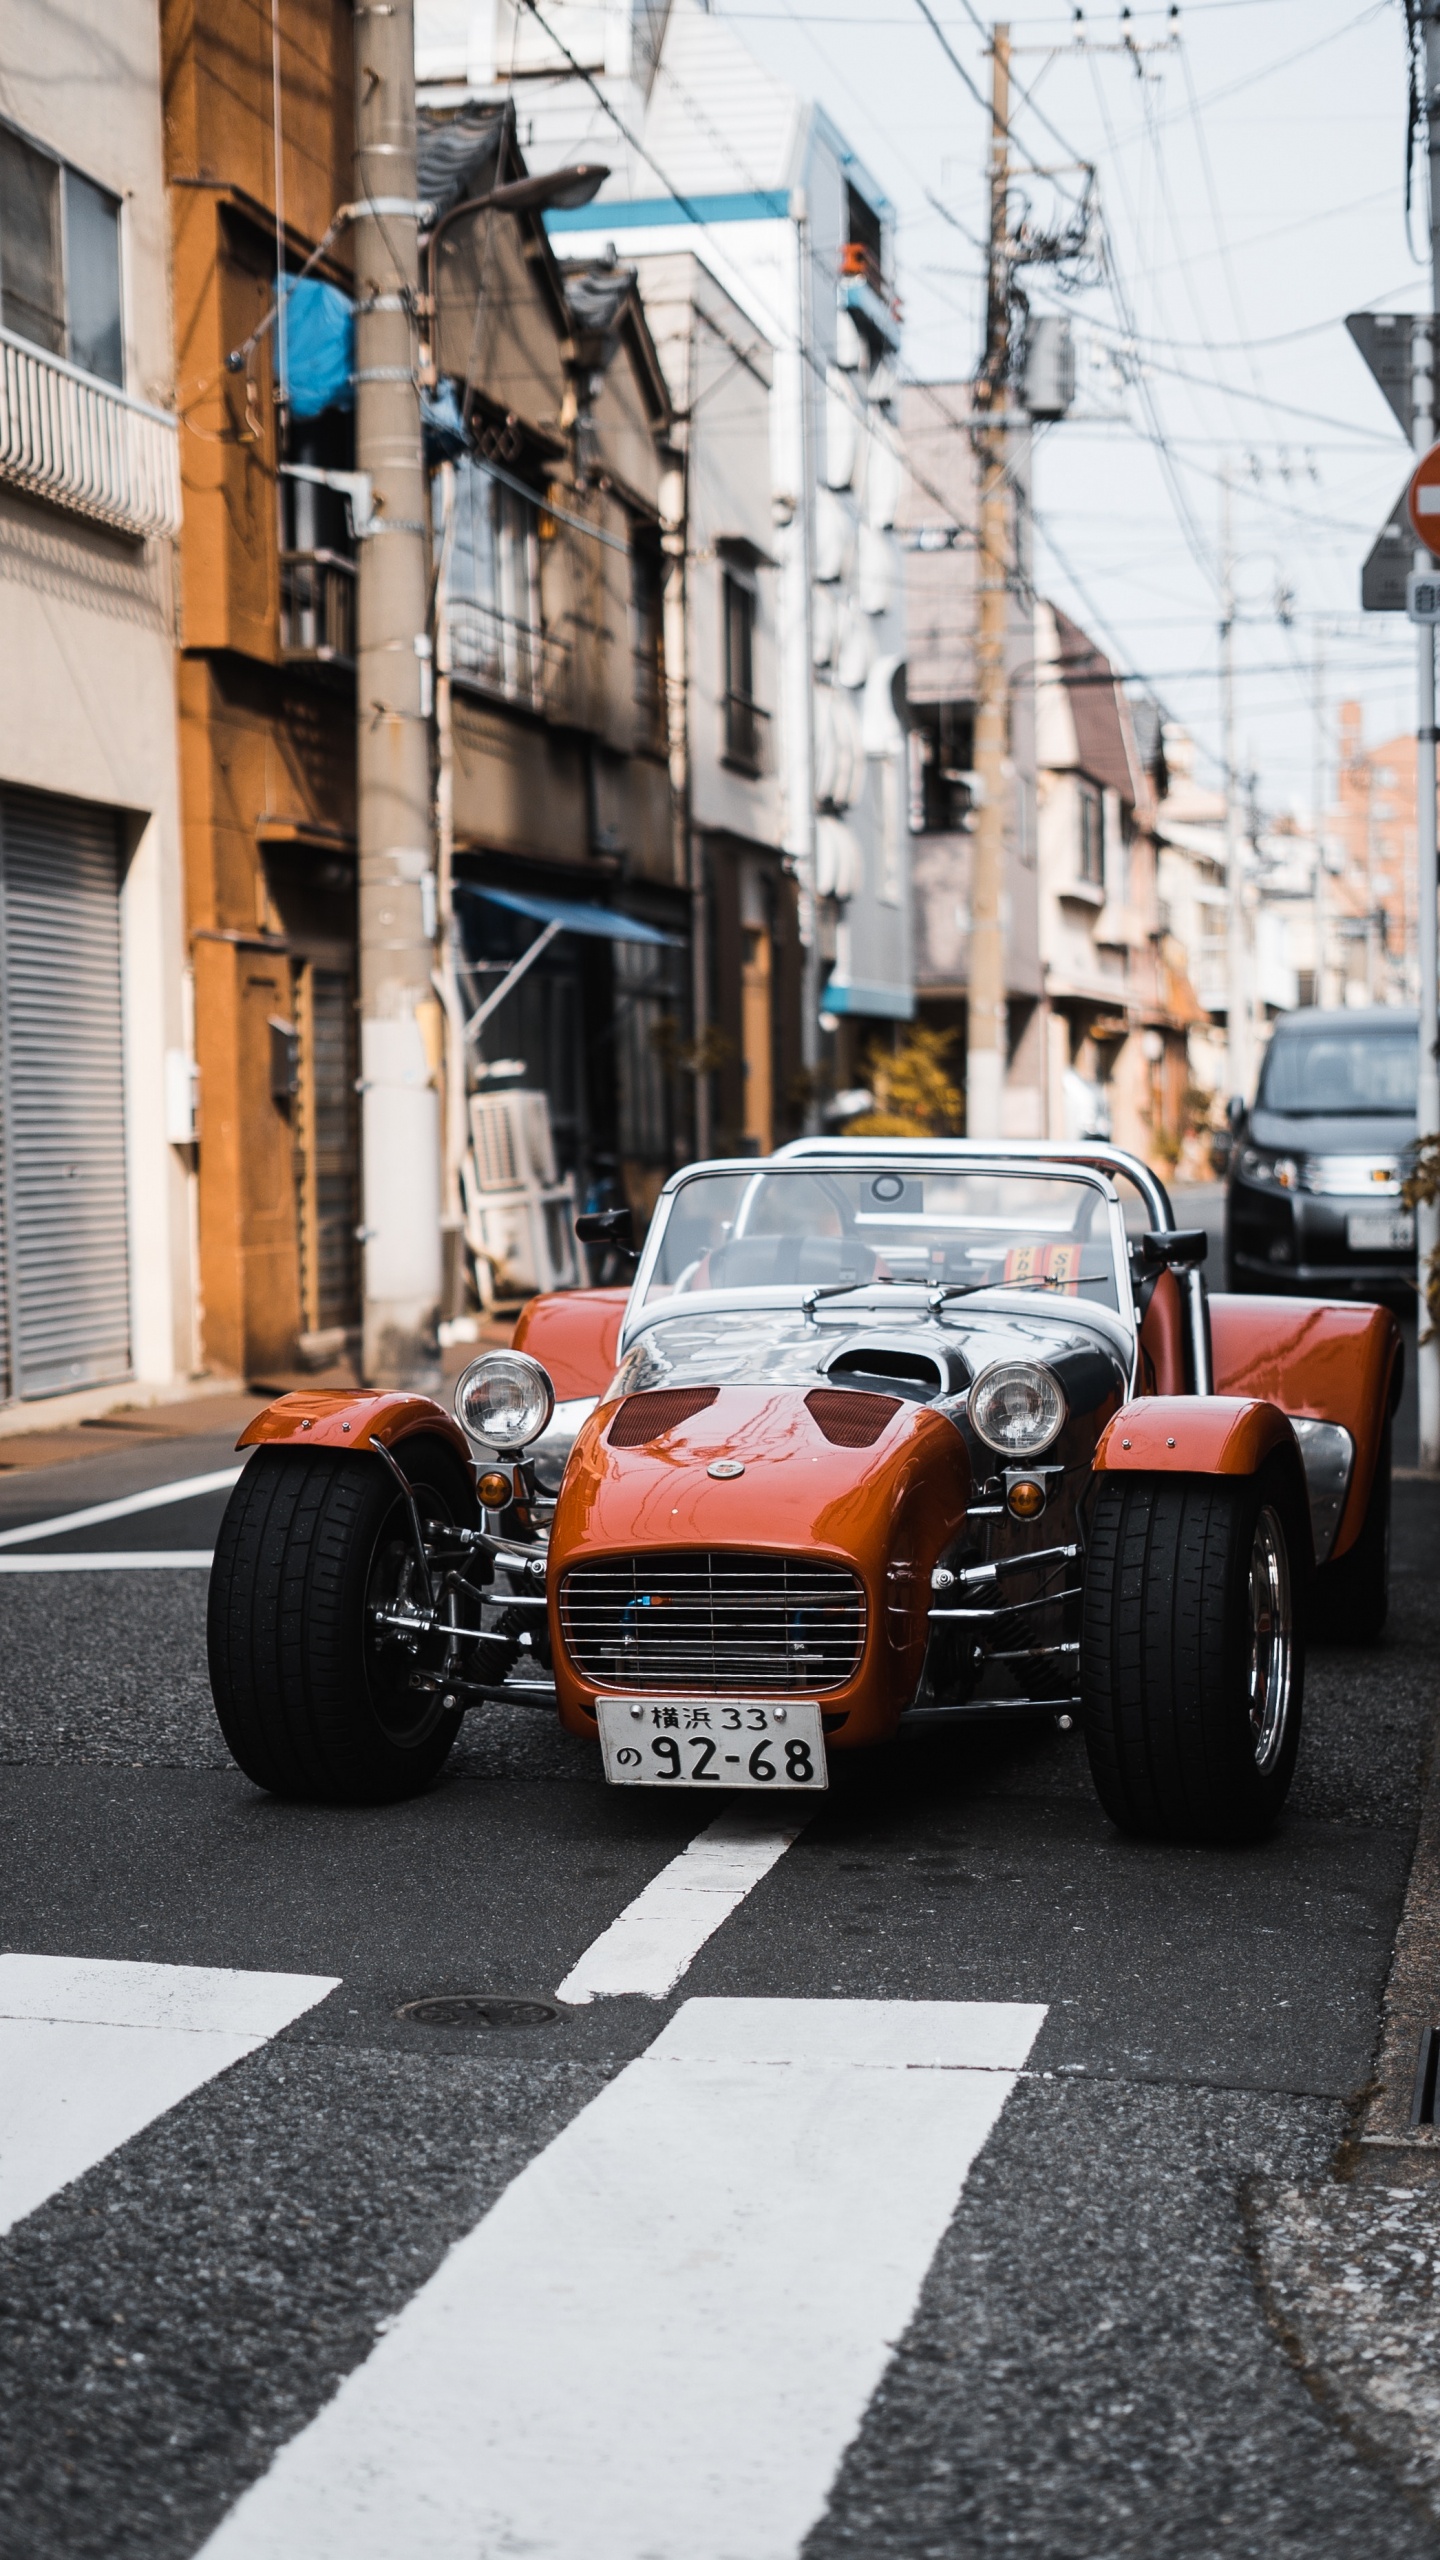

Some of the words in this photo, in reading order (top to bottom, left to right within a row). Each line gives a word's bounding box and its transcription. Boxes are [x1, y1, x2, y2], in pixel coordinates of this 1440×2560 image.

[651, 1706, 713, 1730] 横浜
[721, 1707, 768, 1731] 33
[616, 1747, 642, 1767] の
[651, 1735, 814, 1782] 92-68
